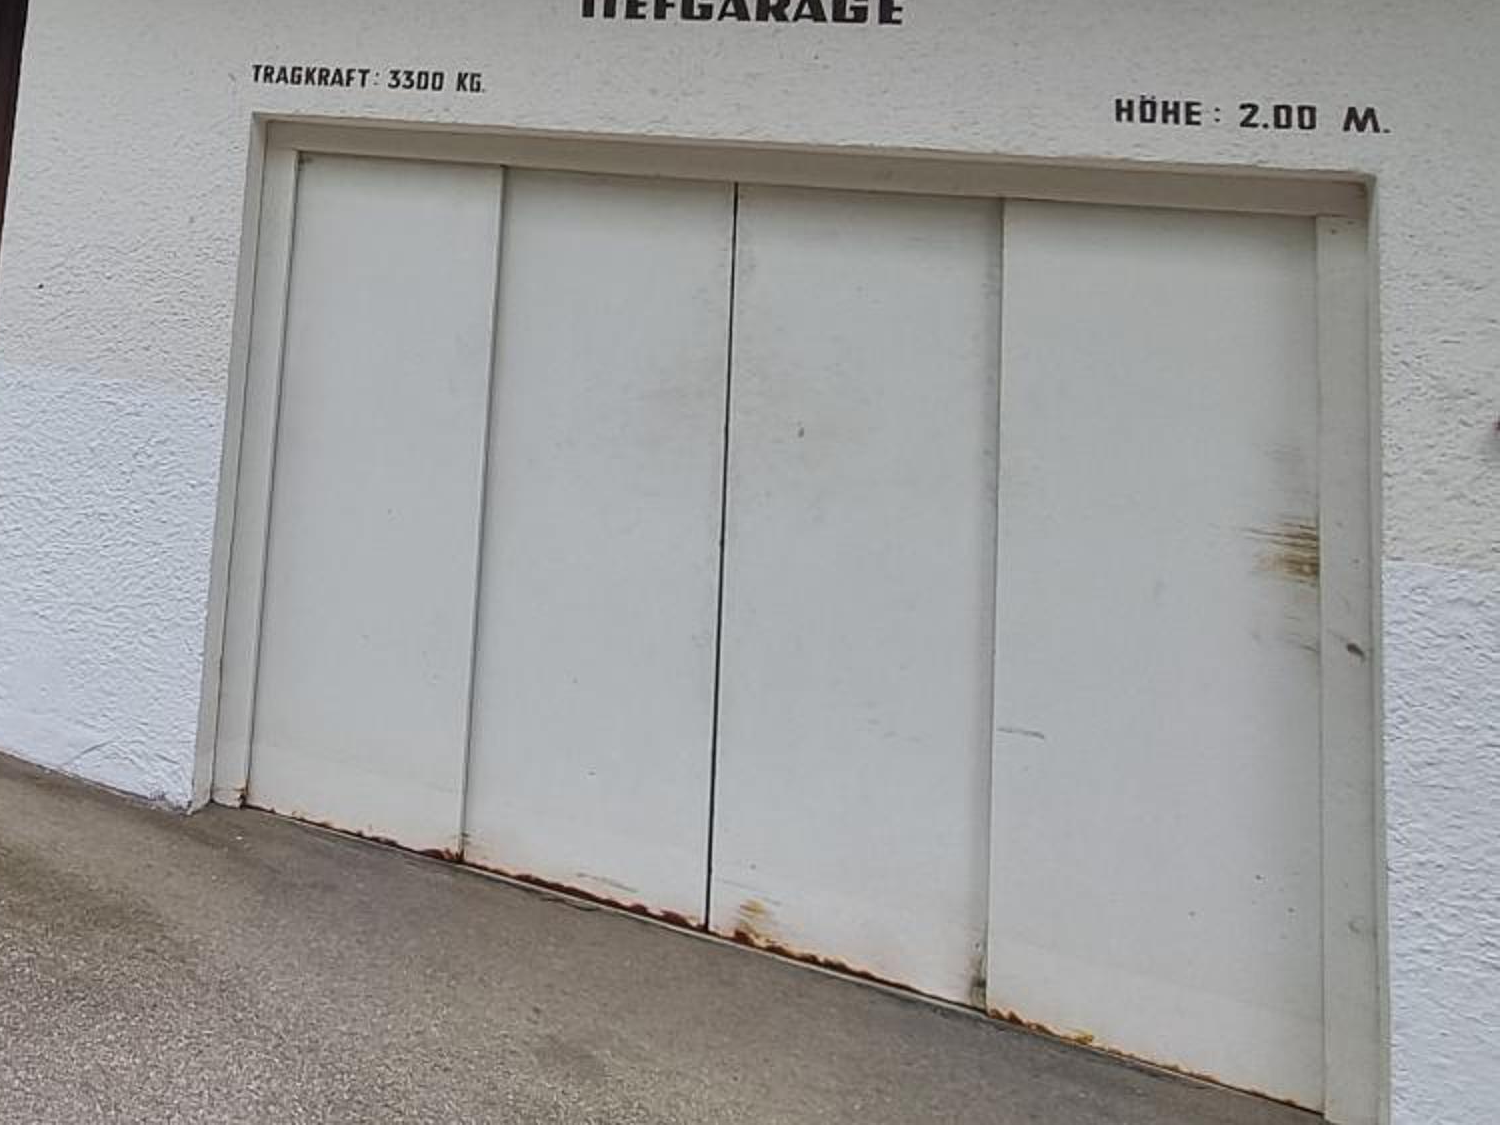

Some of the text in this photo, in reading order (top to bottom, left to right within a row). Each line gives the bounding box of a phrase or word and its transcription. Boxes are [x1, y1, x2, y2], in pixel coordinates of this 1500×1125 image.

[386, 68, 446, 92] 3300
[1237, 101, 1318, 132] 2.00
[1341, 105, 1392, 135] M.
